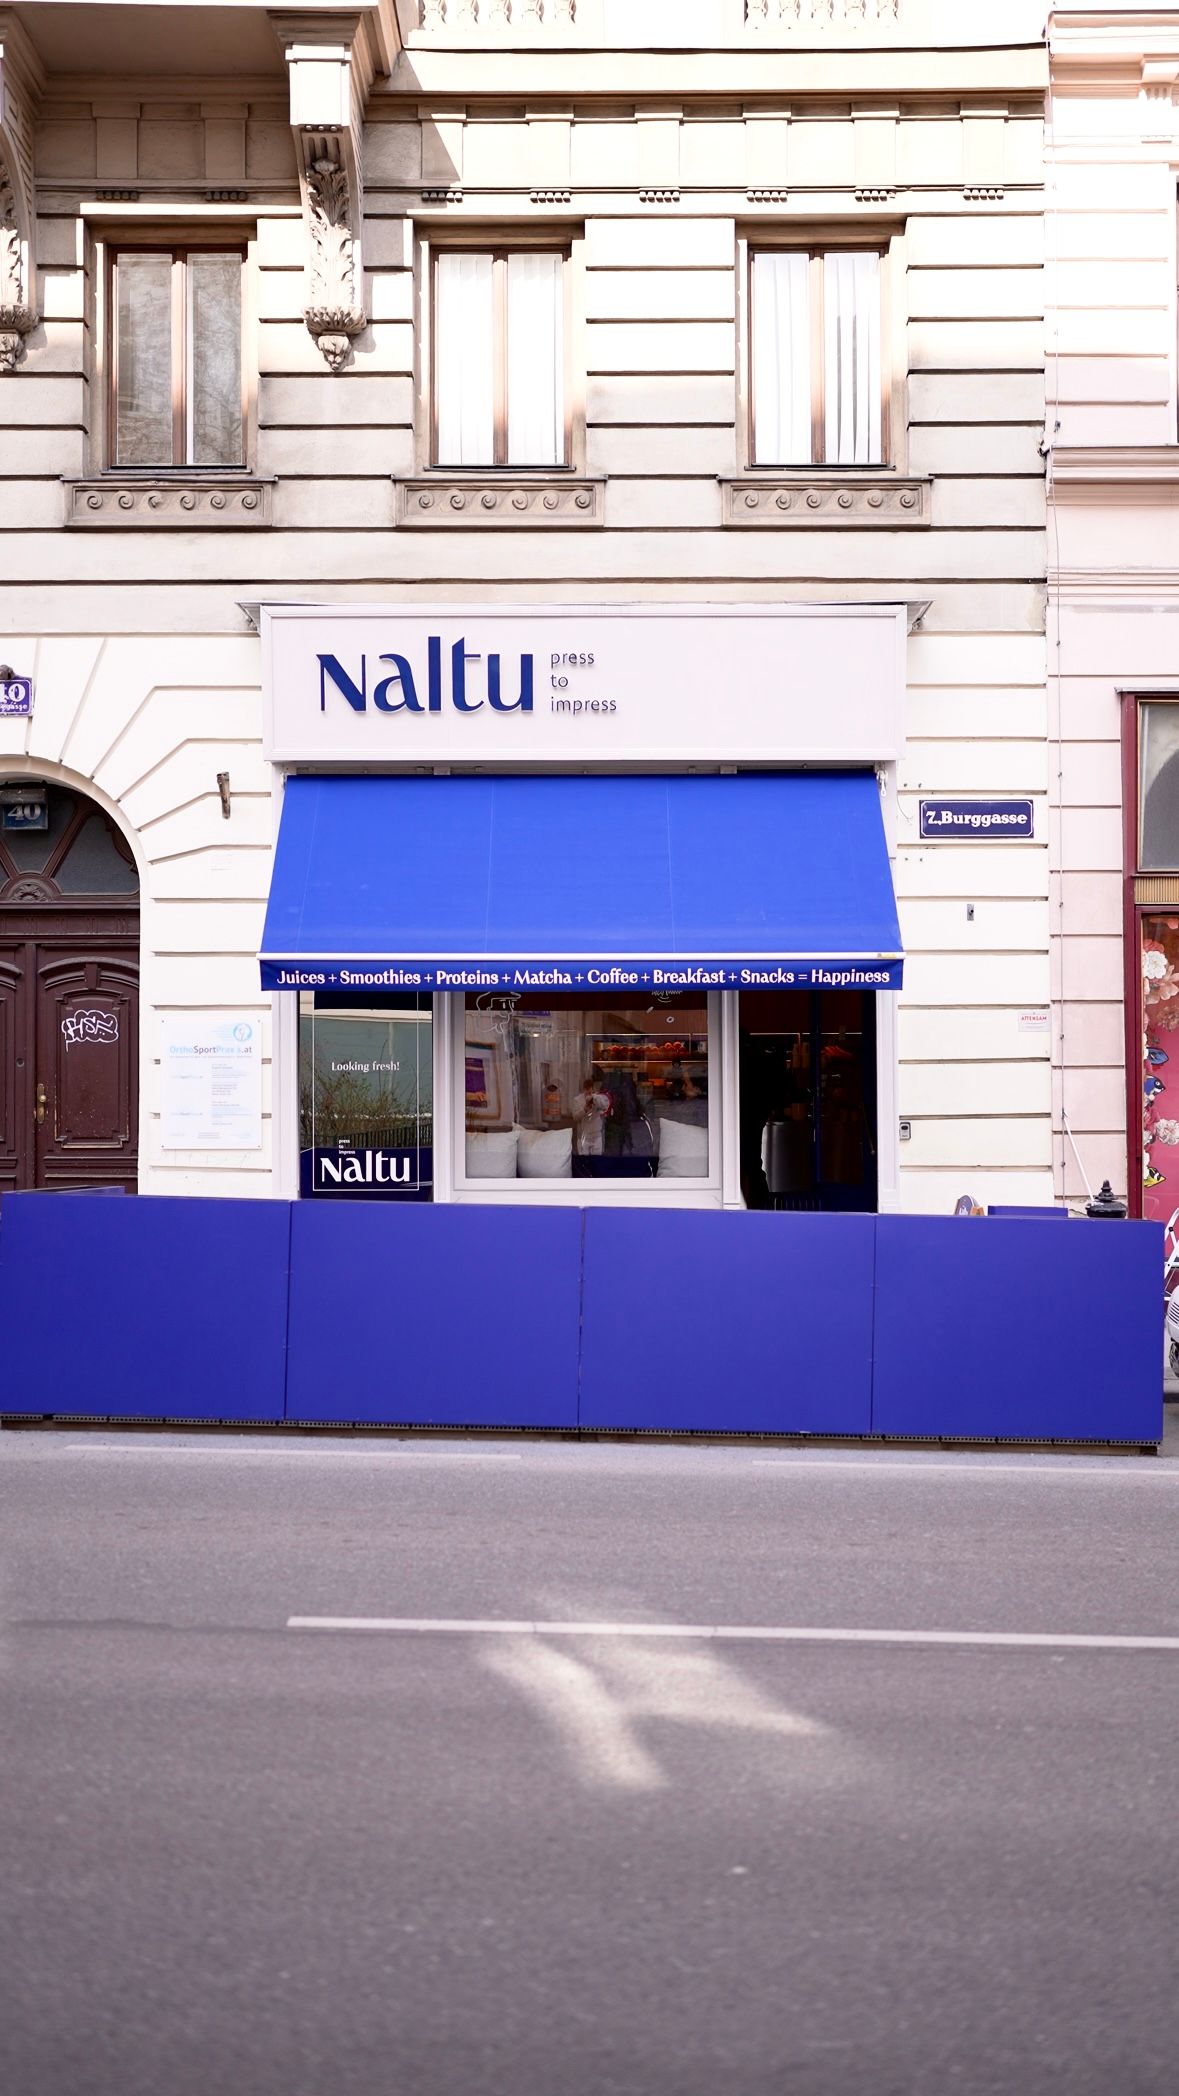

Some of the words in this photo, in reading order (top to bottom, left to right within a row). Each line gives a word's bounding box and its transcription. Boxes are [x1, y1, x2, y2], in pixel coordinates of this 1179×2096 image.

[550, 652, 595, 668] press
[316, 636, 534, 712] Naltu
[550, 674, 569, 687] to
[550, 696, 617, 714] impress
[8, 804, 41, 820] 40
[277, 970, 325, 985] Juices
[339, 969, 421, 985] Smoothies
[436, 970, 499, 985] Proteins
[513, 969, 572, 985] Matcha
[587, 968, 638, 984] Coffee
[653, 968, 726, 984] Breakfast
[740, 968, 795, 984] Snacks
[811, 968, 890, 986] Happiness
[169, 1045, 253, 1055] OrthoSportPraxs.at
[331, 1060, 370, 1073] Looking
[372, 1060, 400, 1071] fresh!
[320, 1150, 410, 1182] Naltu
